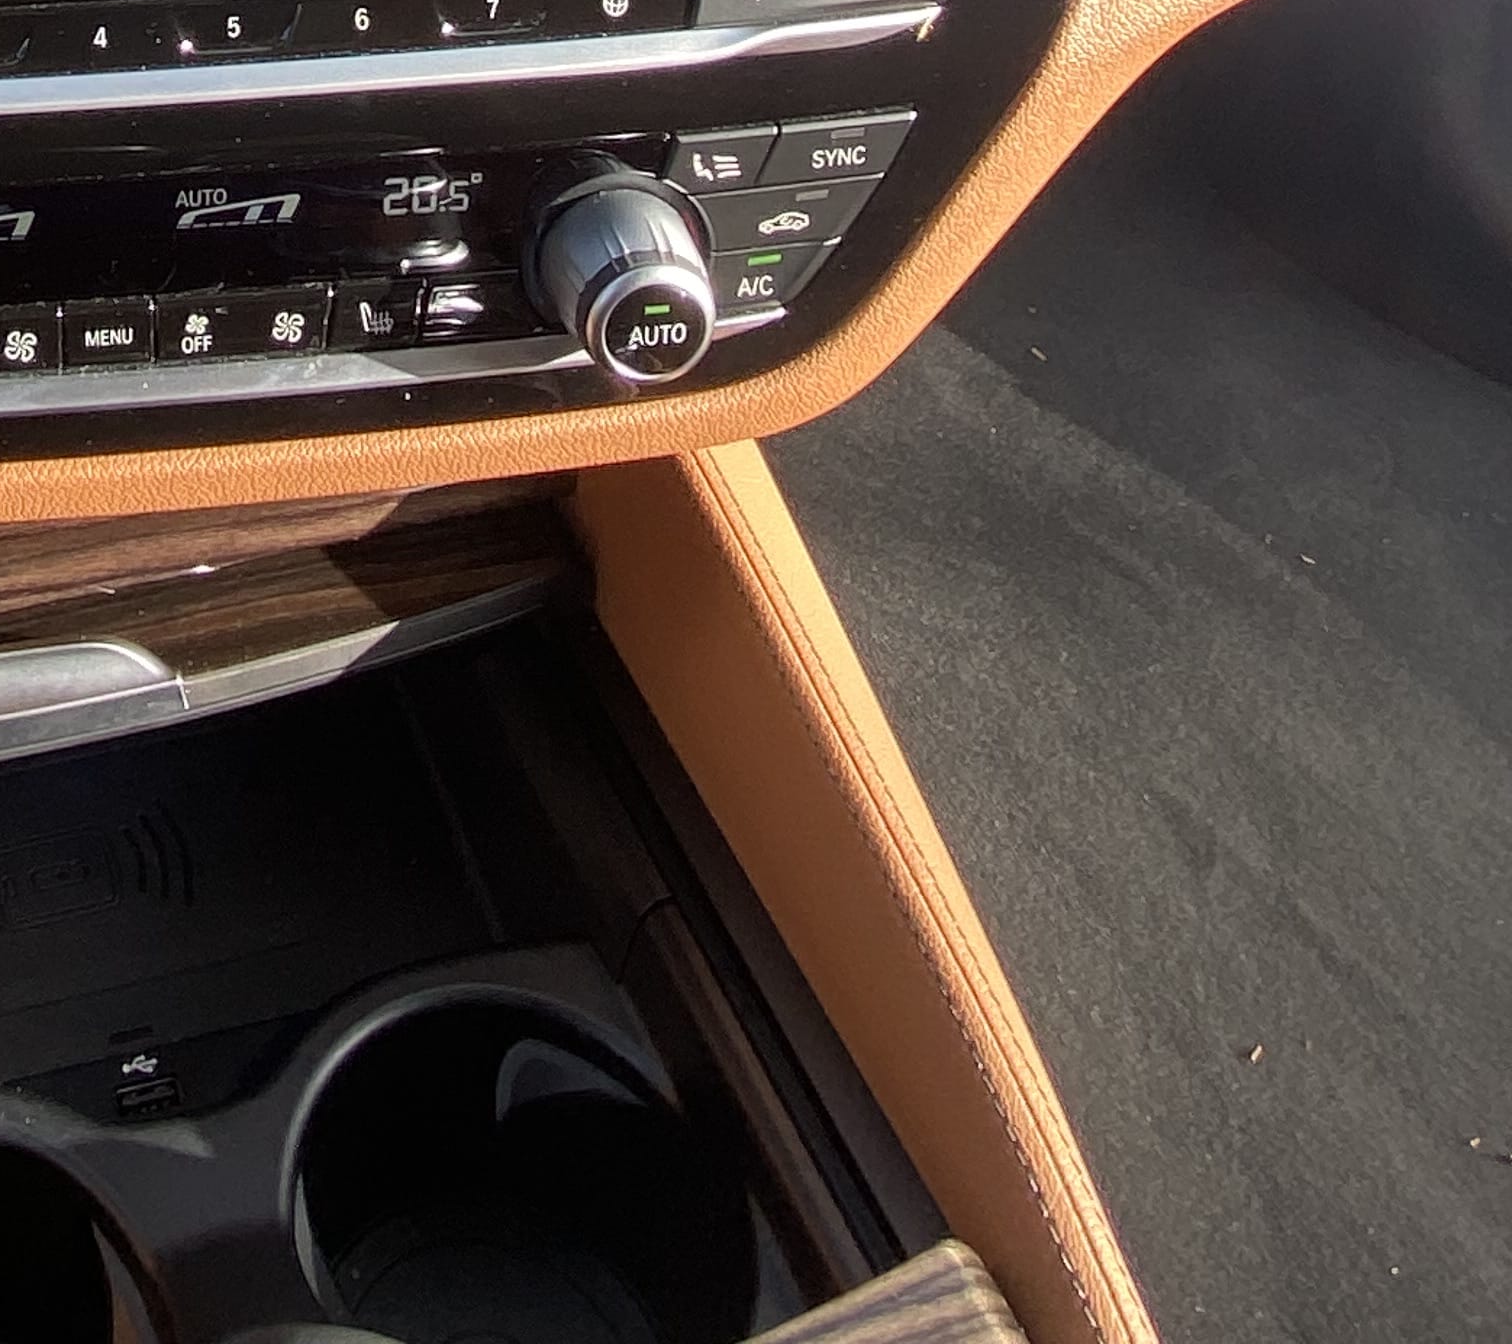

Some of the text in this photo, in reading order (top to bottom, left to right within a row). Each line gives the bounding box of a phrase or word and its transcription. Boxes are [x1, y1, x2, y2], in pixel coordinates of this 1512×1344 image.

[227, 17, 241, 39] 5
[355, 8, 370, 30] 6
[93, 27, 108, 48] 4
[811, 146, 867, 170] SYNC
[175, 188, 228, 209] AUTO
[737, 275, 774, 298] A/C
[85, 328, 134, 347] MENU
[181, 336, 213, 354] OFF
[629, 323, 687, 348] AUTO
